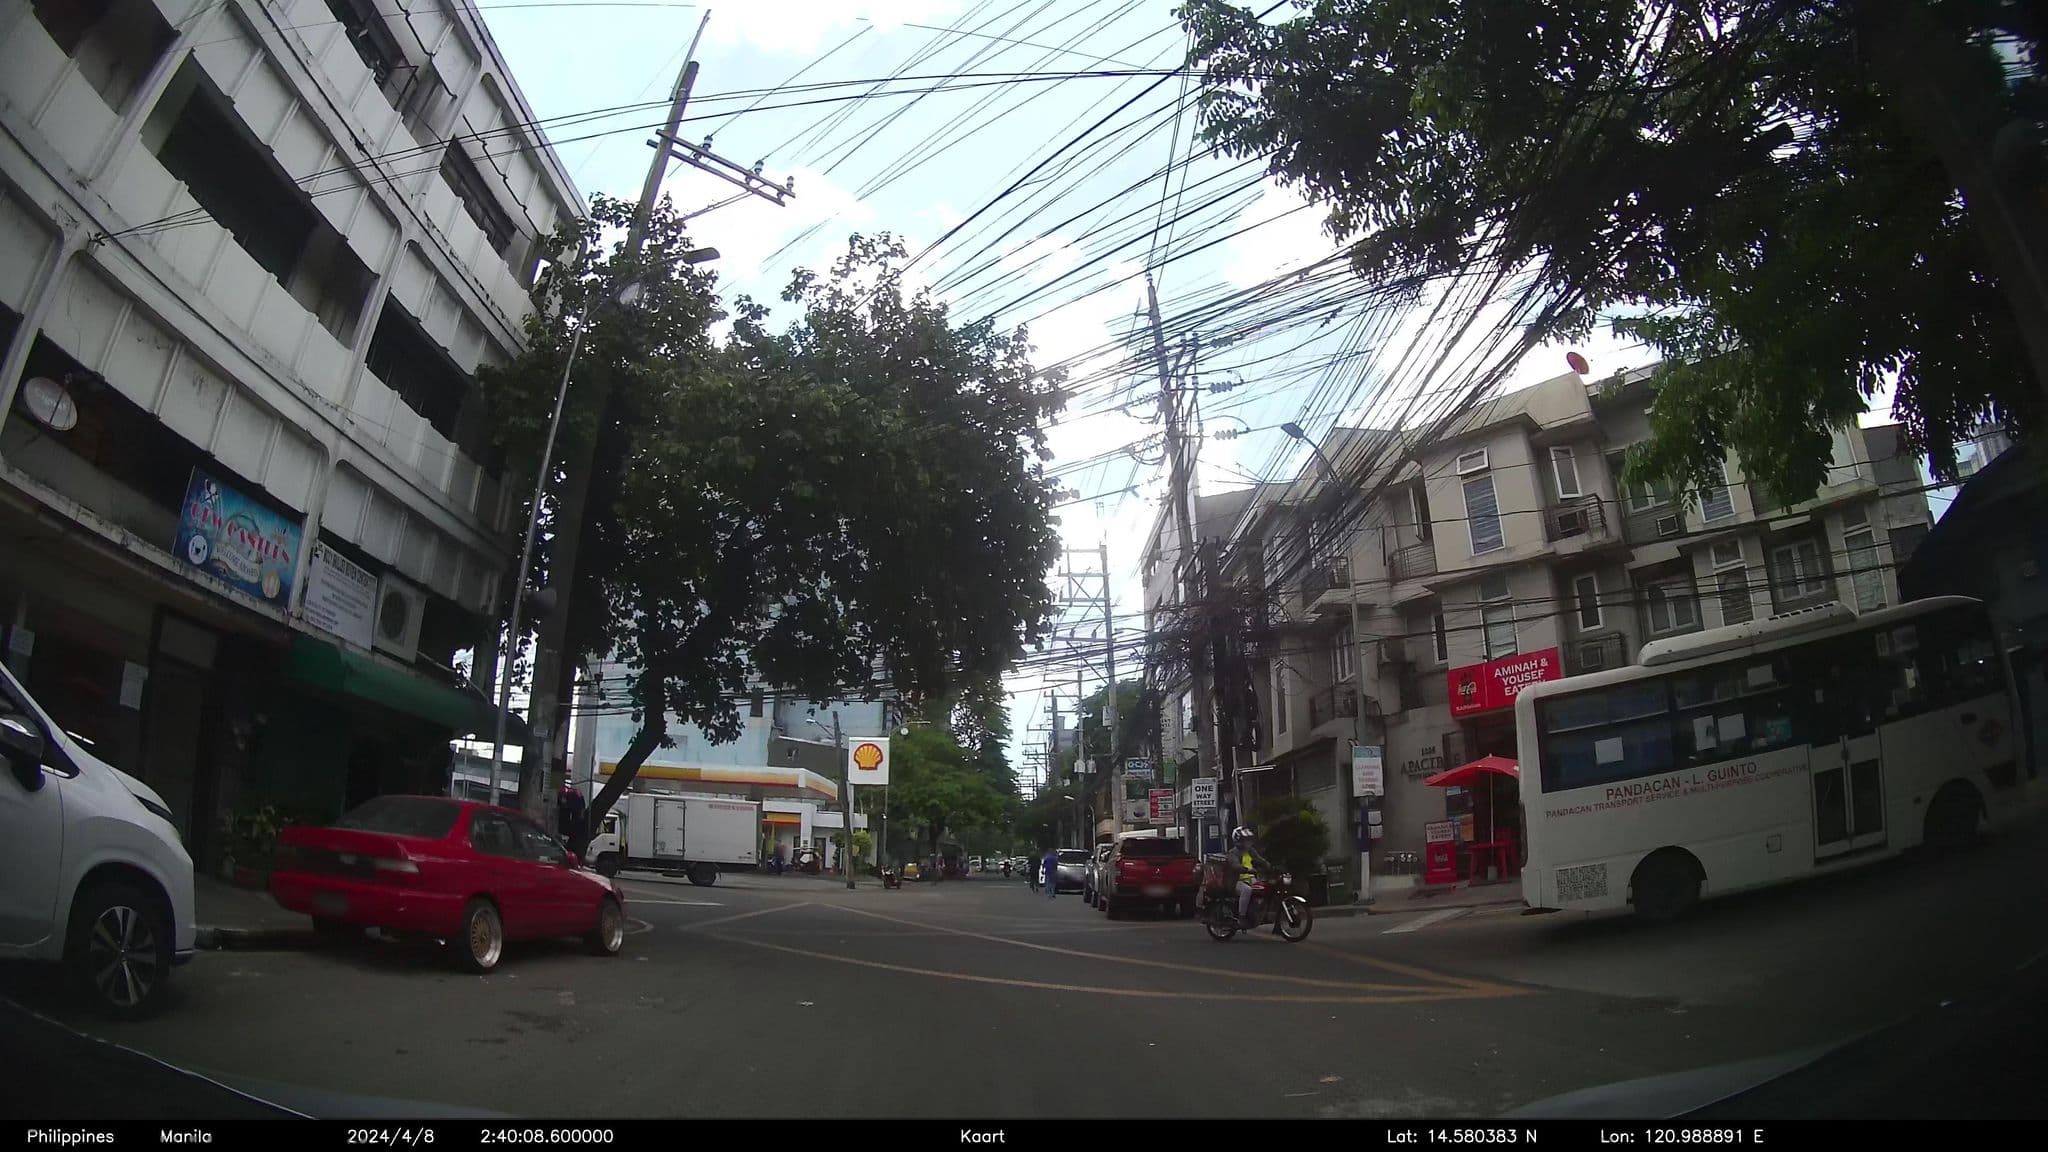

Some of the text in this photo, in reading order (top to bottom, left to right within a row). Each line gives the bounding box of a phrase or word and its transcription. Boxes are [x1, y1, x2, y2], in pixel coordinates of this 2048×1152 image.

[1494, 657, 1549, 679] AMINAH &
[1502, 669, 1545, 686] YOUSEF
[1194, 785, 1214, 793] ONE
[1606, 776, 1681, 801] PANDACAN
[1693, 773, 1704, 786] L.
[1707, 761, 1758, 783] GUINTO
[1546, 804, 1592, 819] PANDACAN
[1593, 796, 1643, 813] TRANSPORT
[1645, 788, 1681, 803] SERVICE
